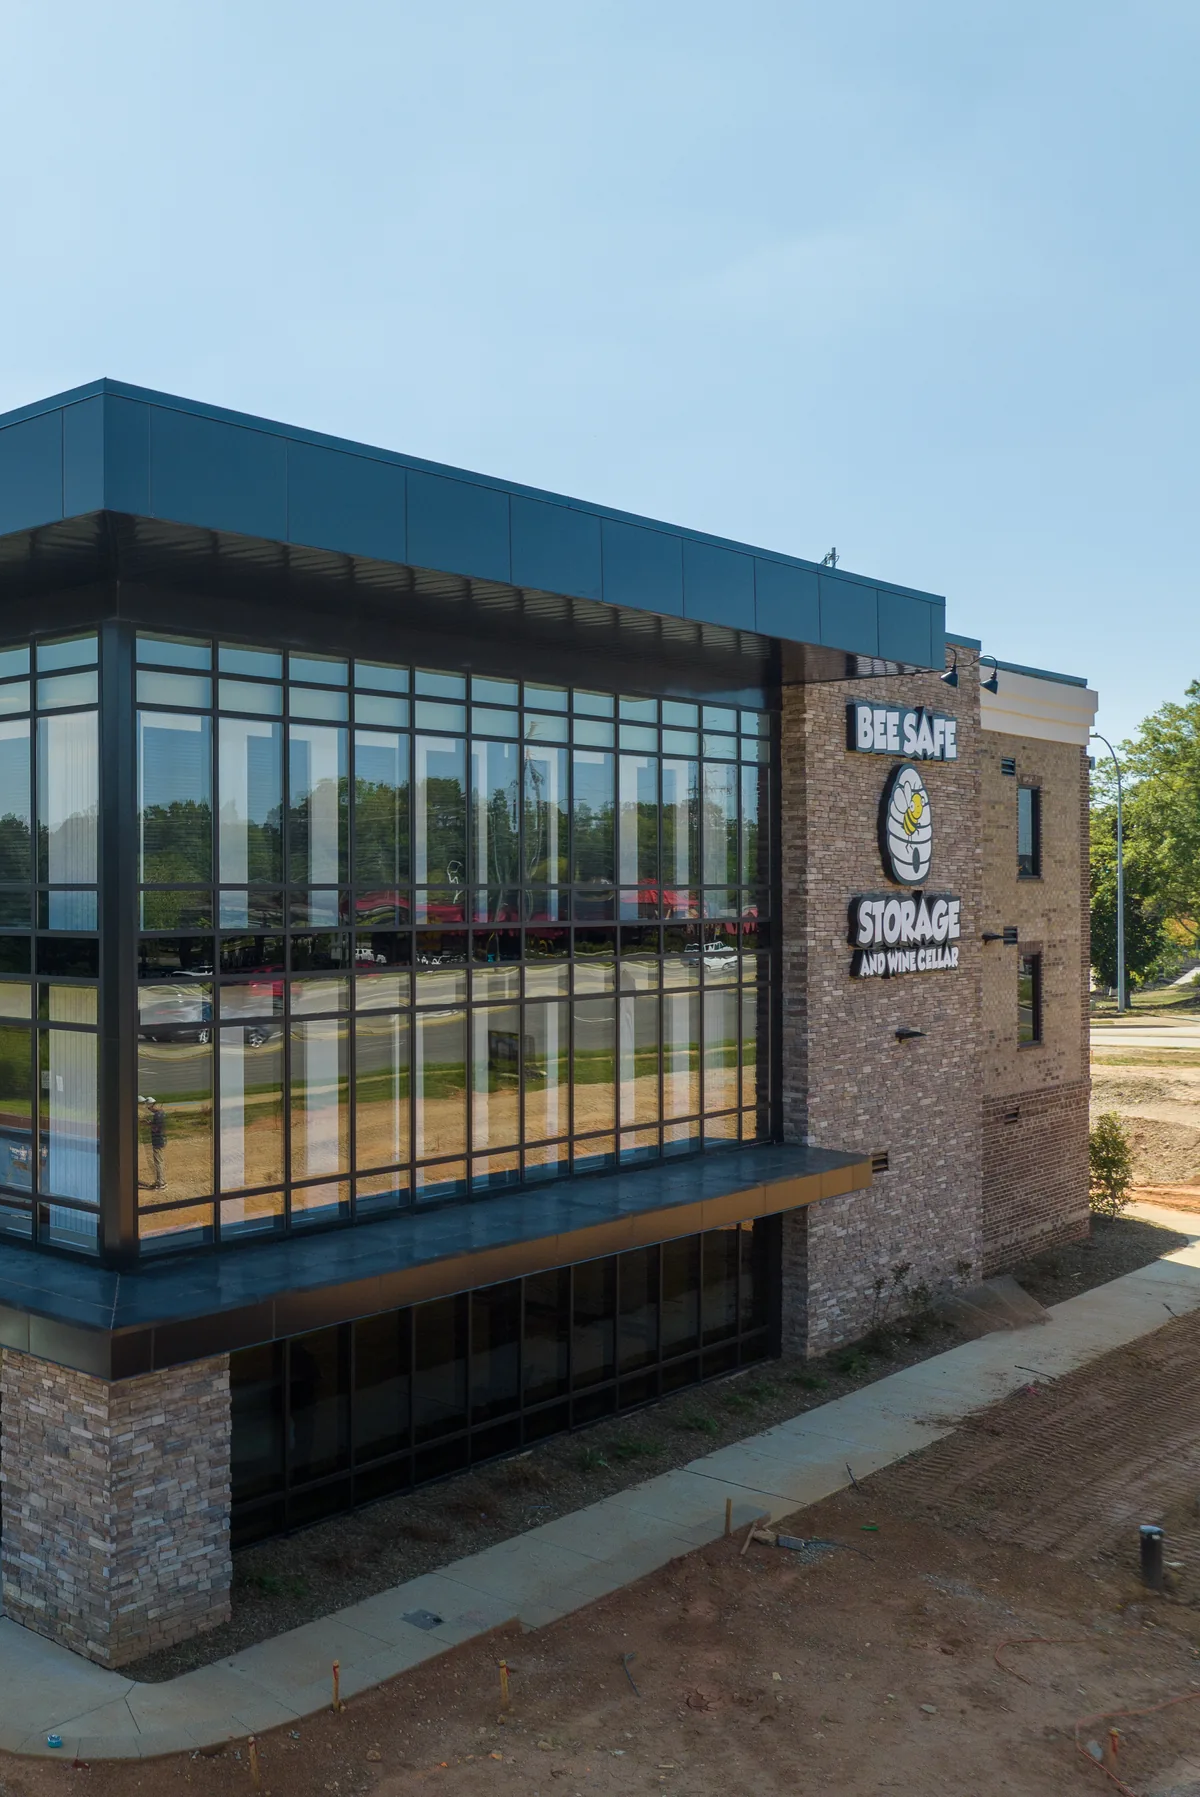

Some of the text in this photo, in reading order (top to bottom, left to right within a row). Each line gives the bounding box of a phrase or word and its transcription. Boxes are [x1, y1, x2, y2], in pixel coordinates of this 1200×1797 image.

[857, 706, 957, 758] BEE SAFE
[858, 898, 960, 944] STORAGE
[860, 945, 959, 977] AND WINE CELLAR
